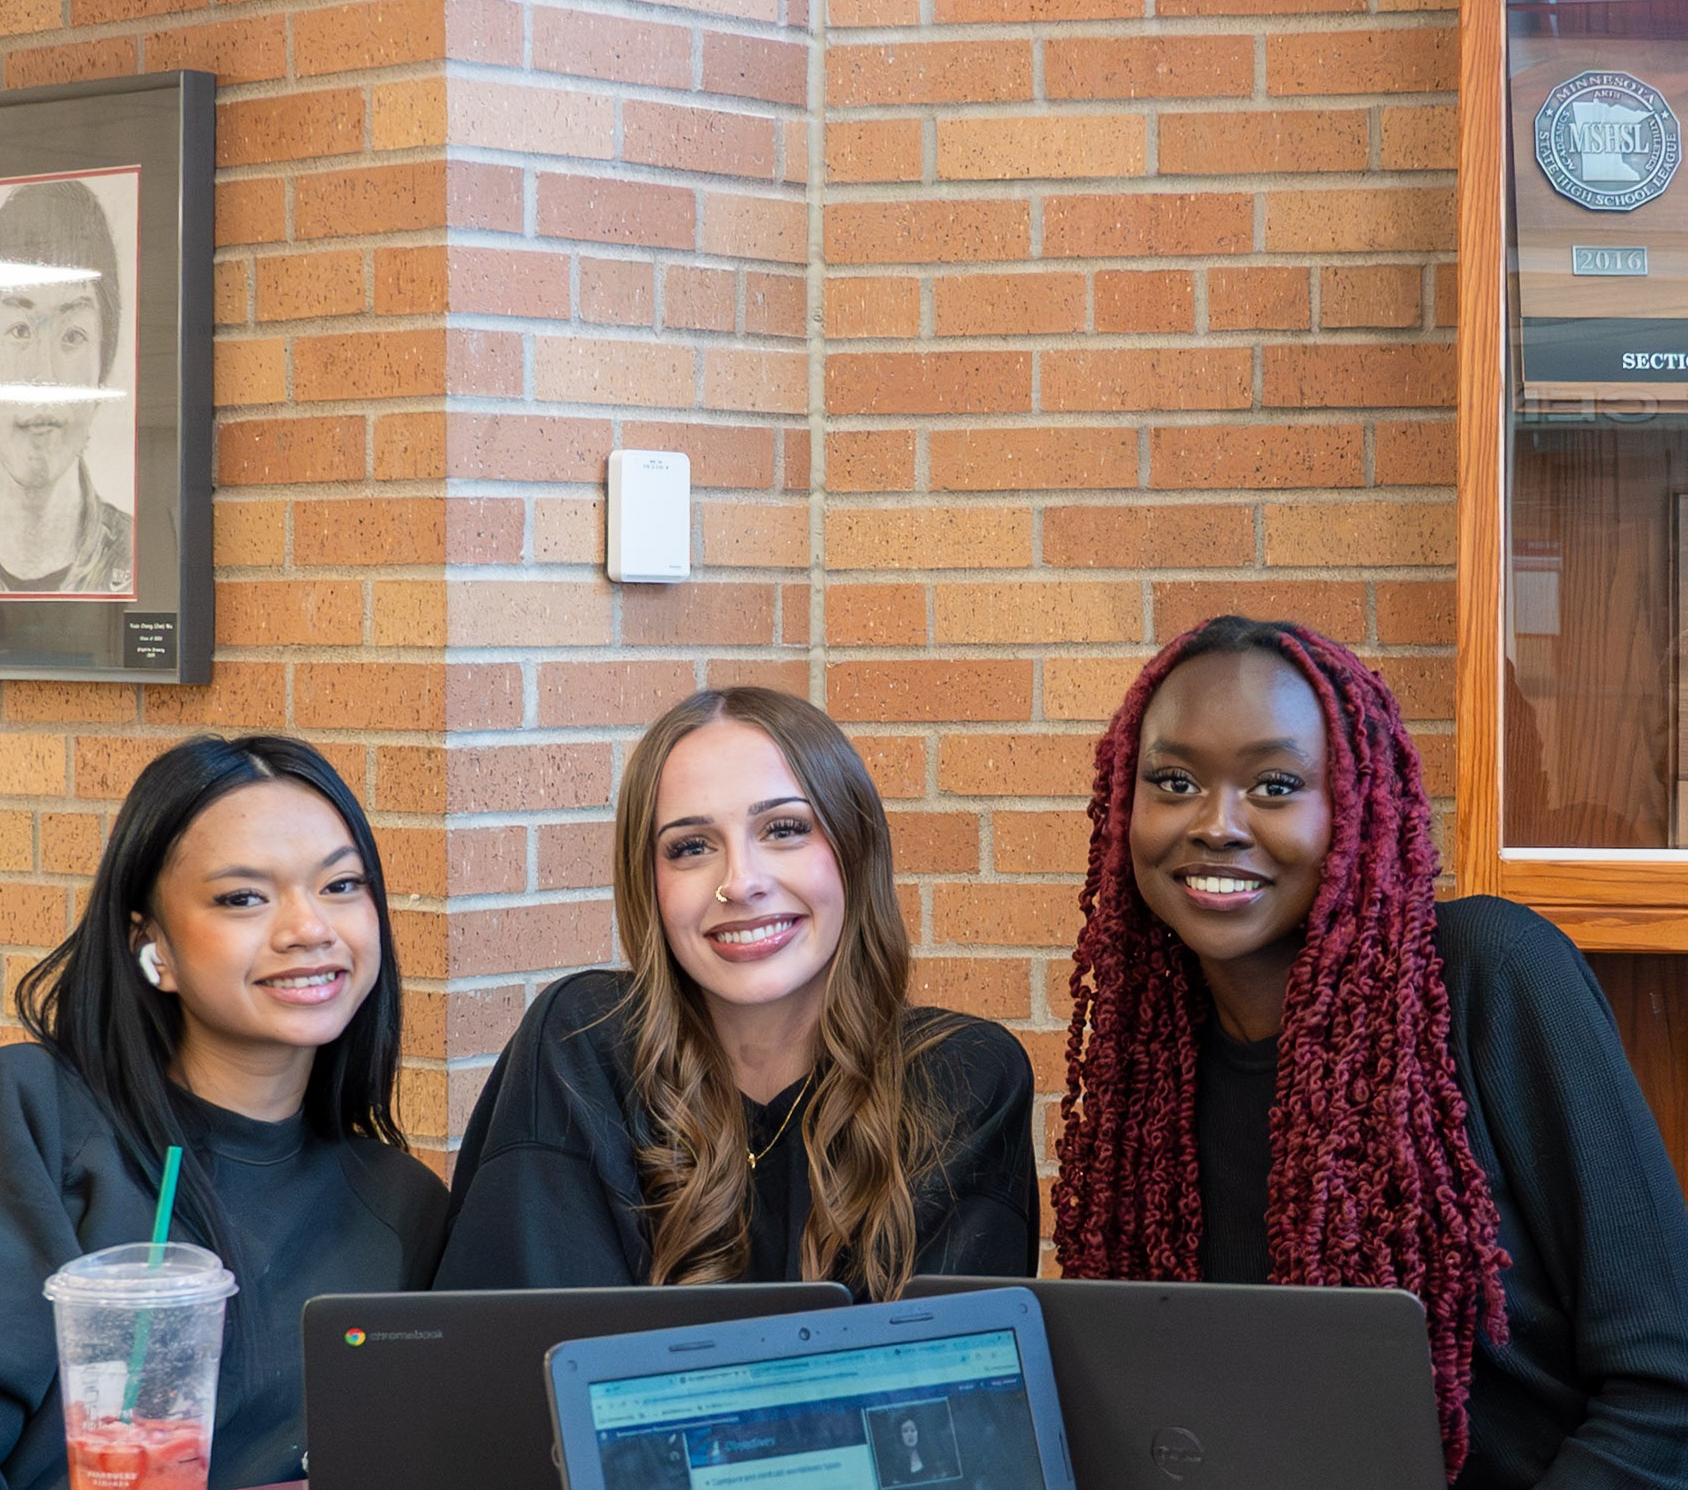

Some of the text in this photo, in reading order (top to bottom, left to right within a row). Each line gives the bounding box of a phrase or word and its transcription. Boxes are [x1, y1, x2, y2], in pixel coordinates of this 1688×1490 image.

[1556, 75, 1655, 105] MINNESOTA
[1569, 123, 1649, 154] MSHSL
[1539, 131, 1676, 206] STATE HIGH SCHOOL LEAGUE
[1580, 250, 1642, 270] 2016
